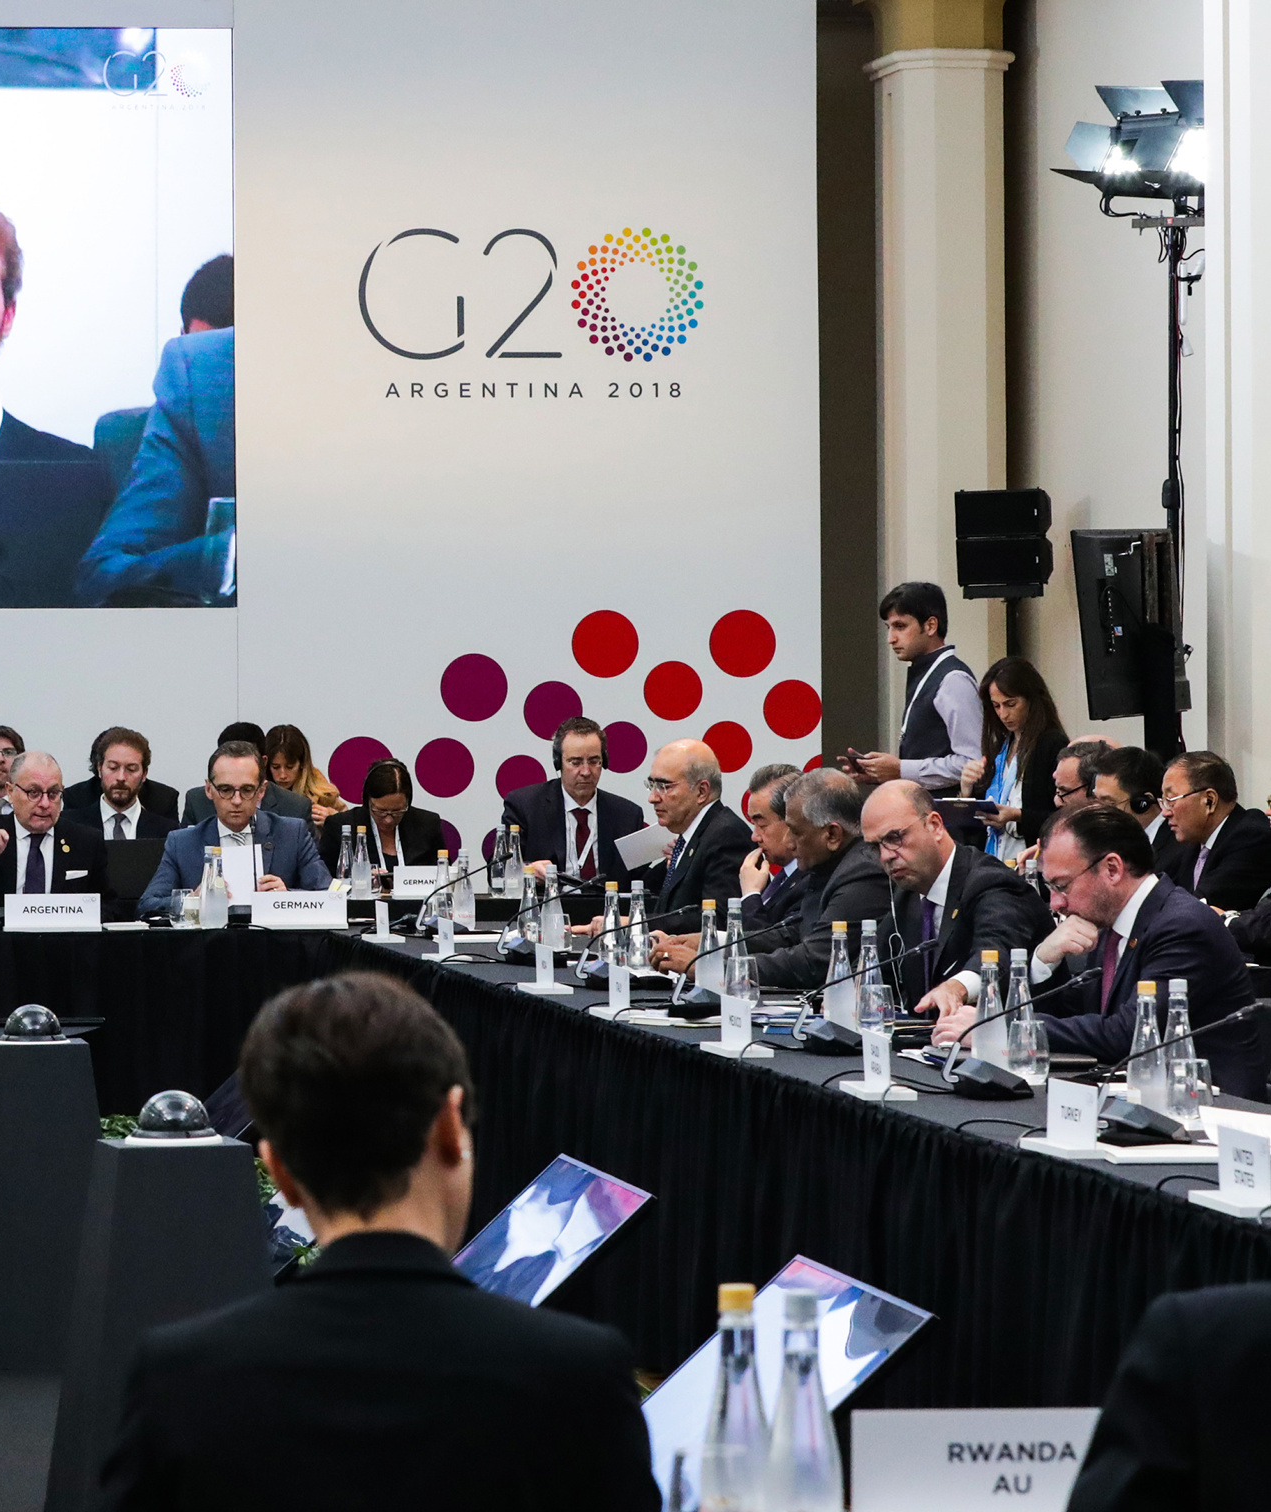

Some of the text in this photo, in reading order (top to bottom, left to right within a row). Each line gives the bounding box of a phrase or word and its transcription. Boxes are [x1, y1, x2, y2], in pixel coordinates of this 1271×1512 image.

[358, 227, 704, 362] G20
[385, 382, 682, 399] ARGENTINA 2018
[22, 906, 84, 914] ARGENTINA
[272, 901, 325, 909] GERMANY
[947, 1441, 1077, 1463] RWANDA
[993, 1474, 1032, 1495] AU
